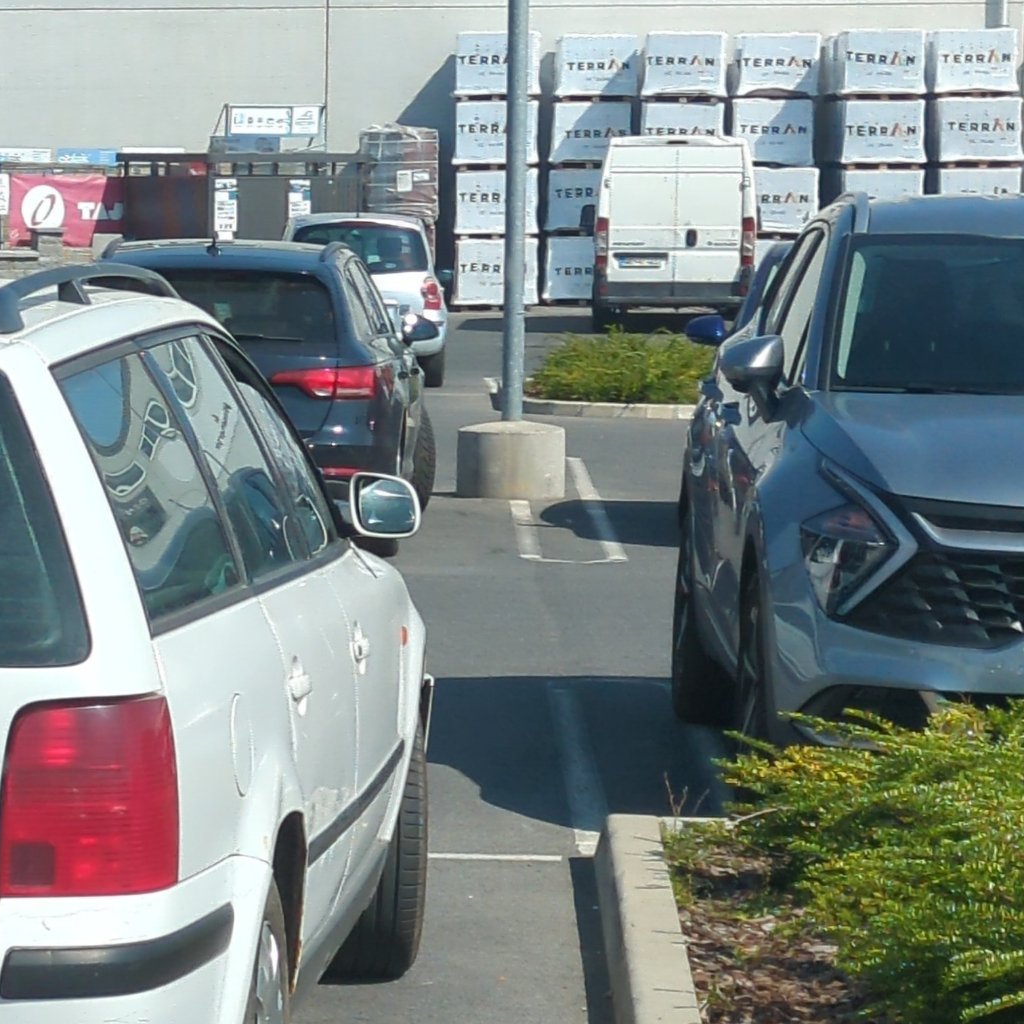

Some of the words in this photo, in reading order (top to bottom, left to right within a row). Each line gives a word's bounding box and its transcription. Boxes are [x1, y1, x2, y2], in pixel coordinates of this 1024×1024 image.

[458, 54, 509, 65] TERR
[458, 124, 508, 134] TERR
[459, 192, 502, 203] TERR
[554, 188, 595, 199] TERR
[761, 192, 809, 204] RRAN
[460, 263, 502, 273] TERR
[554, 267, 593, 276] TERR
